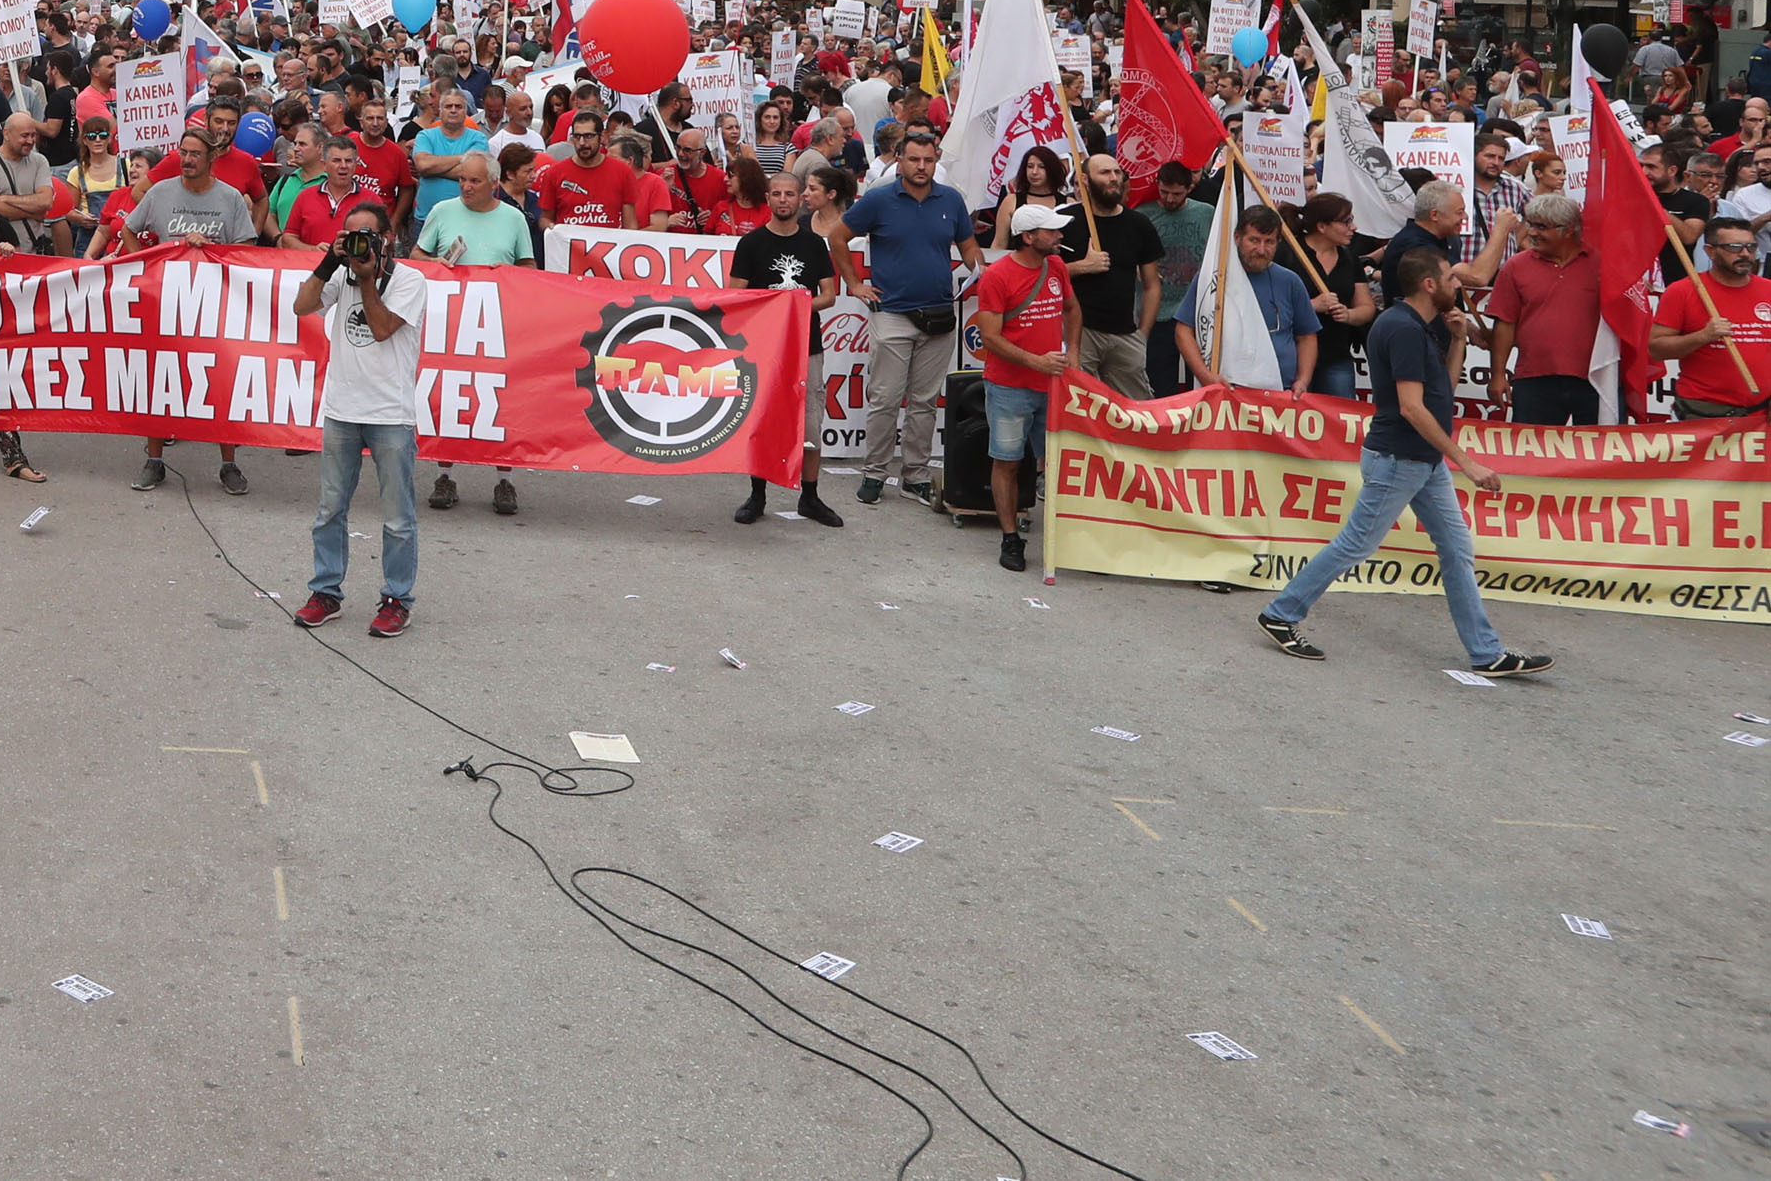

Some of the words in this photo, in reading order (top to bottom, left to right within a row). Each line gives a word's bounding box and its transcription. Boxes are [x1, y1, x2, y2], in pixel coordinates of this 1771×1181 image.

[684, 73, 736, 91] ΚΑΤΑΡΓΗΣΗ
[125, 82, 174, 102] ΚΑΝΕΝΑ
[123, 106, 154, 123] ΣΠΙΤΙ
[157, 104, 178, 118] ΣΤΑ
[690, 101, 702, 116] ΟΥ
[706, 99, 739, 113] ΝΟΜΟΥ
[135, 124, 170, 141] ΧΕΡΙΑ
[1252, 145, 1300, 157] ΙΜΠΕΡΙΑΛΙΣΤΕΣ
[1396, 151, 1461, 167] ΚΑΝΕΝΑ
[1268, 160, 1276, 169] ΓΗ
[1272, 186, 1295, 196] ΛΑΩΝ
[168, 215, 224, 236] Chaot!
[104, 347, 216, 419] ΜΑΣ
[594, 355, 744, 398] Π.Α.ΜΕ
[635, 445, 699, 457] ΠΑΝΕΡΓΑΤΙΚΟ
[701, 411, 743, 448] ΑΓΩΝΙΣΤΙΚΟ
[740, 375, 751, 411] ΜΕΤΩΠΟ
[1064, 384, 1160, 435] ΣΤΟΝ
[1171, 400, 1324, 442] ΠΟΛΕΜΟ
[1457, 425, 1694, 462] ΑΠΑΝΤΑΜΕ
[1057, 449, 1266, 518] ΕΝΑΝΤΙΑ
[1279, 472, 1346, 523] ΣΕ
[1621, 582, 1653, 605] Ν.
